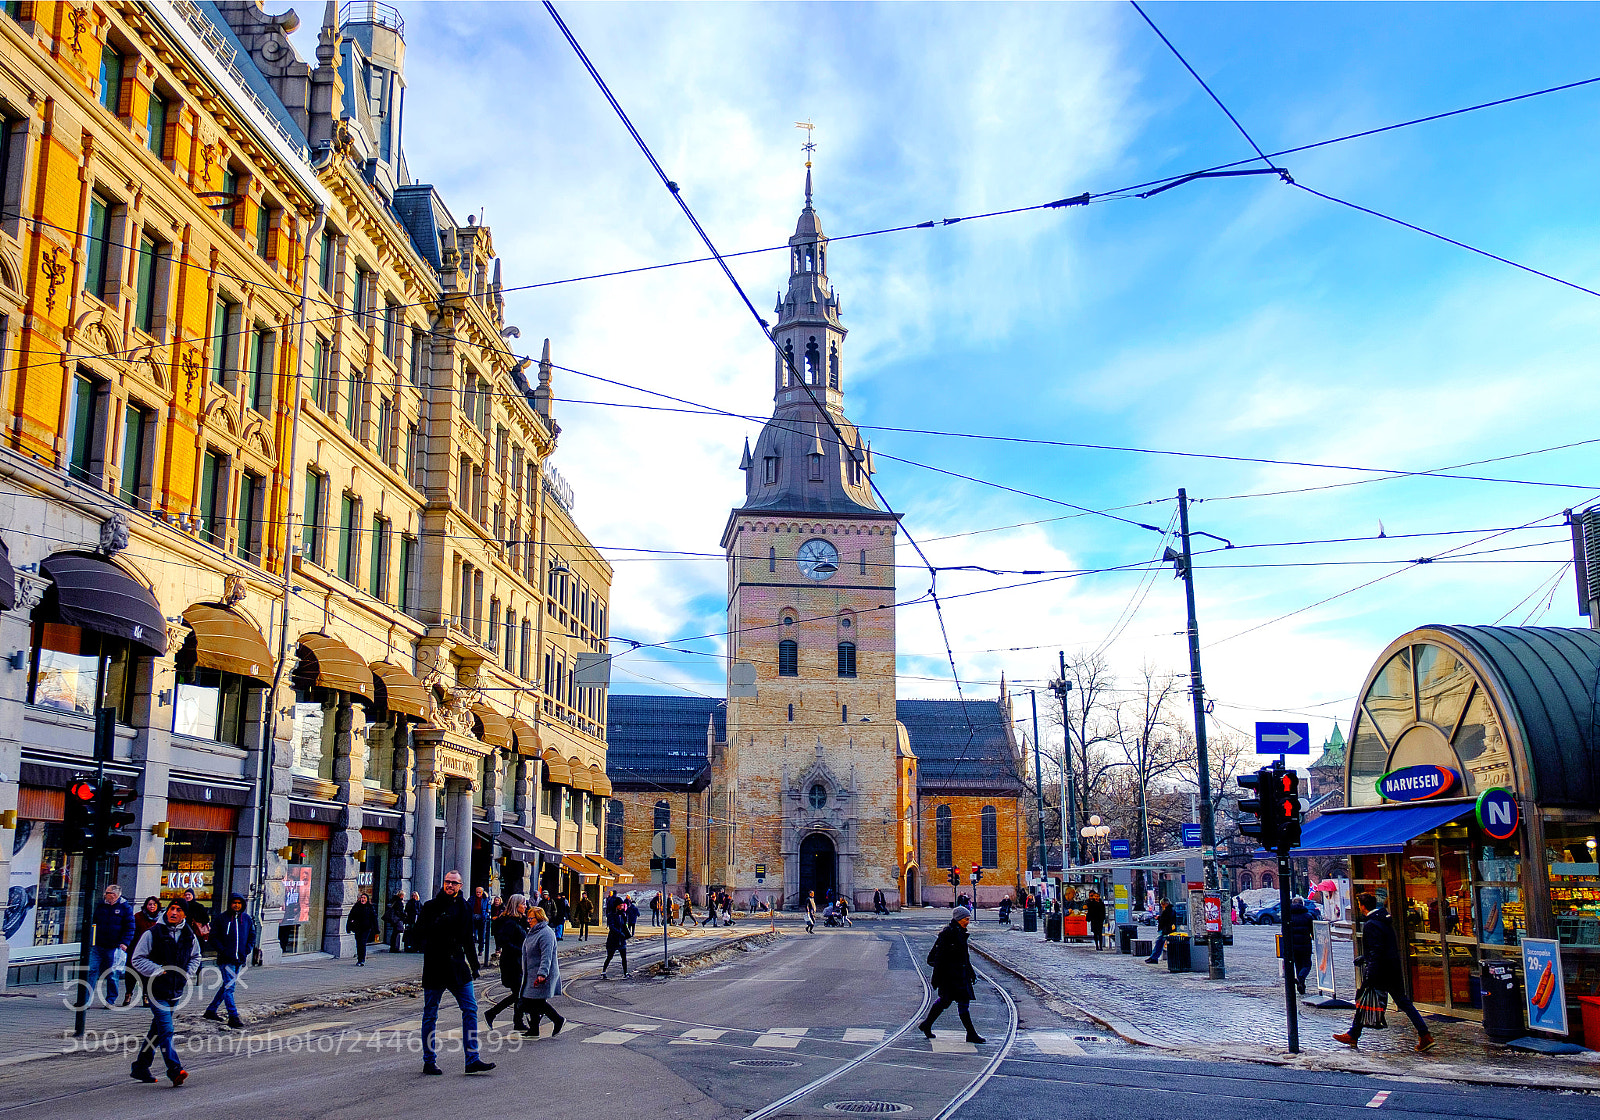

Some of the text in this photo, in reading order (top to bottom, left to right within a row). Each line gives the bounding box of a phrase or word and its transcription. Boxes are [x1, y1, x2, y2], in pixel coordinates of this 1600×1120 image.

[1385, 774, 1439, 793] NARVESEN
[1487, 801, 1512, 825] N
[168, 872, 204, 889] KICKS
[357, 873, 374, 885] ICKS
